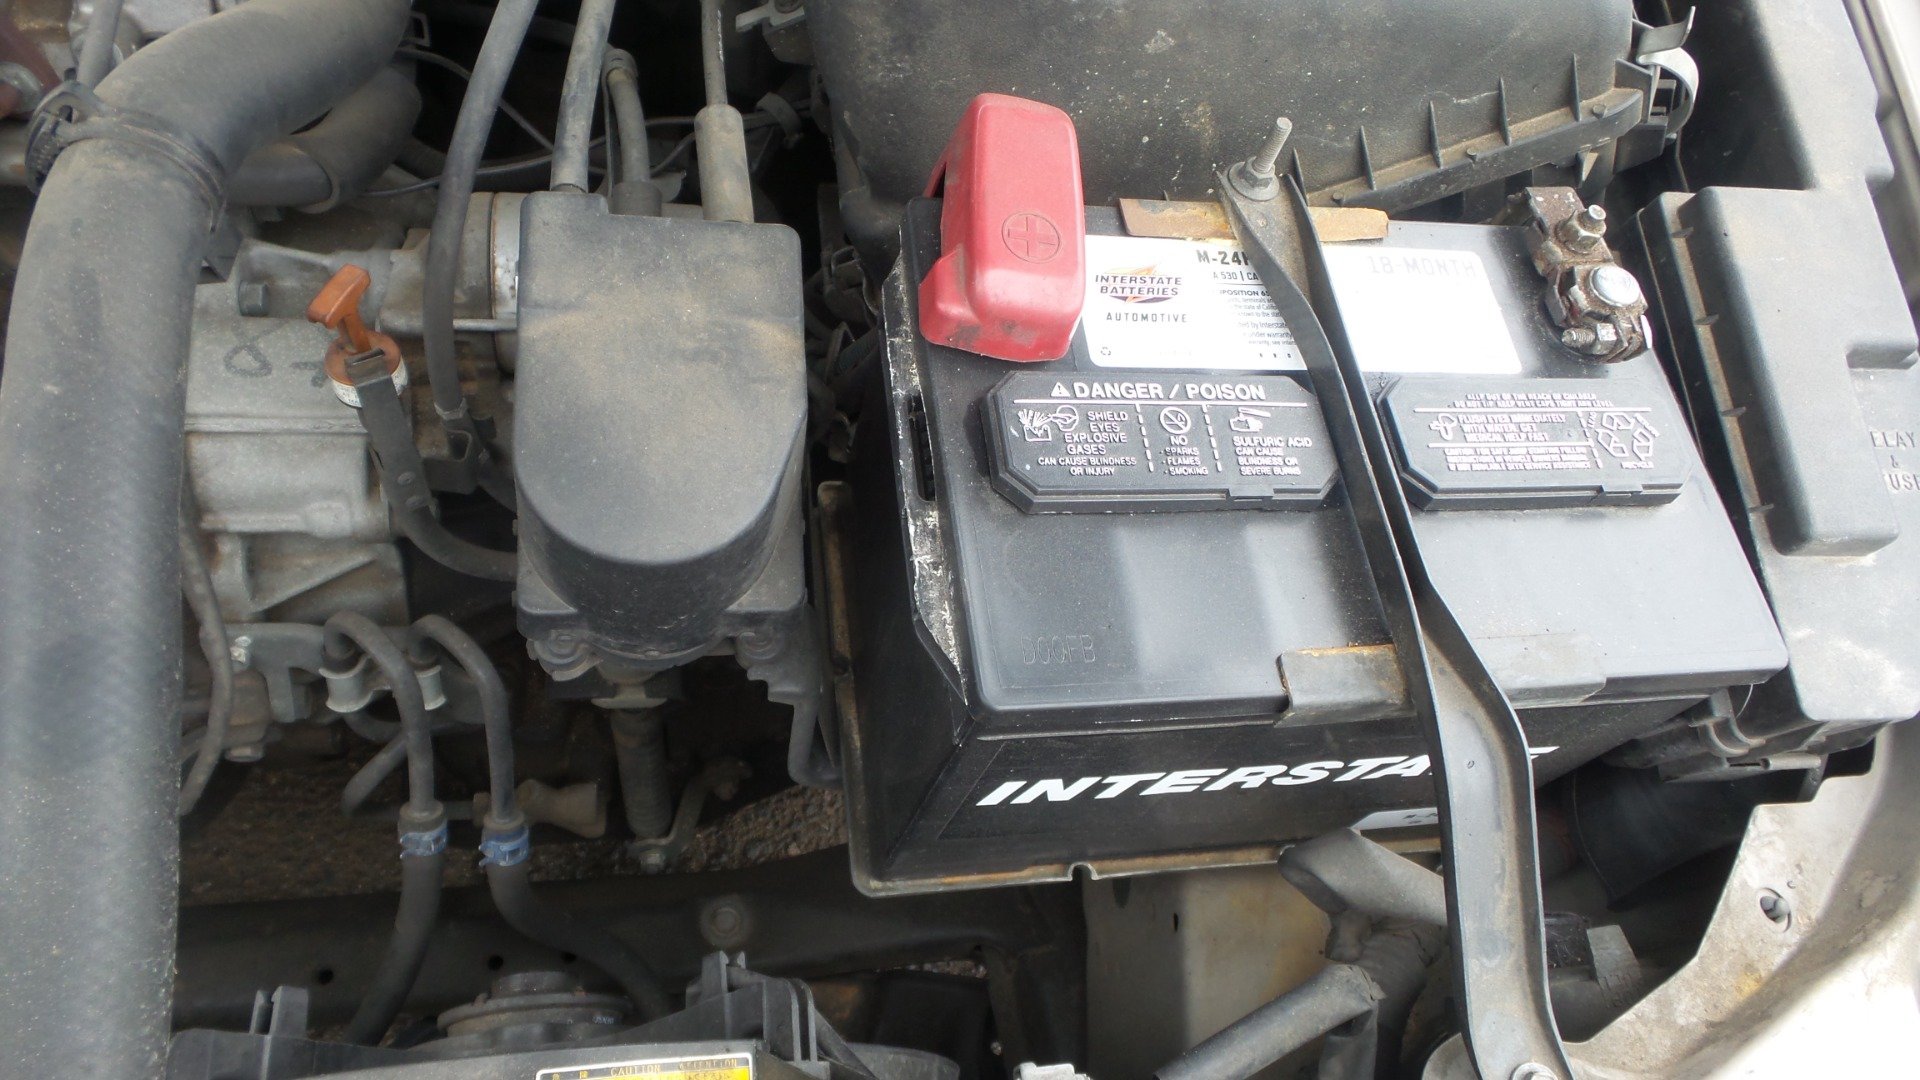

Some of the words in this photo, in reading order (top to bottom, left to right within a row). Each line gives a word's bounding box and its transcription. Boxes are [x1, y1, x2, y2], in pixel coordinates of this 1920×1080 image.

[1367, 255, 1477, 277] 18-MONTH
[1095, 274, 1182, 286] INTERSTATE
[1220, 271, 1238, 280] 530
[1099, 285, 1179, 296] BATTERIES
[1106, 312, 1188, 323] AUTOMOTIVE
[1073, 381, 1164, 399] DANGER
[1185, 382, 1266, 400] POISON
[1087, 410, 1129, 421] SHIELD
[1089, 421, 1120, 433] EYES
[1064, 432, 1128, 443] EXPLOSIVE
[1170, 435, 1188, 446] NO
[1233, 436, 1285, 447] SULFURIC
[1286, 436, 1313, 448] ACID
[1066, 443, 1107, 455] GASES
[1165, 447, 1200, 457] SPARKS
[1235, 447, 1253, 457] CAN
[1255, 447, 1285, 457] CAUSE
[1038, 456, 1057, 465] CAN
[1058, 456, 1088, 466] CAUSE
[1090, 457, 1137, 466] BLINDNESS
[1166, 457, 1201, 466] FLAMES
[1237, 457, 1284, 466] BLINDNESS
[1286, 457, 1299, 466] OR
[1070, 467, 1084, 476] OR
[1085, 467, 1116, 476] INJURY
[1169, 467, 1209, 476] SMOKING
[1240, 466, 1272, 476] SEVERE
[975, 745, 1559, 806] INTERSTA
[610, 1064, 661, 1077] CAUTION
